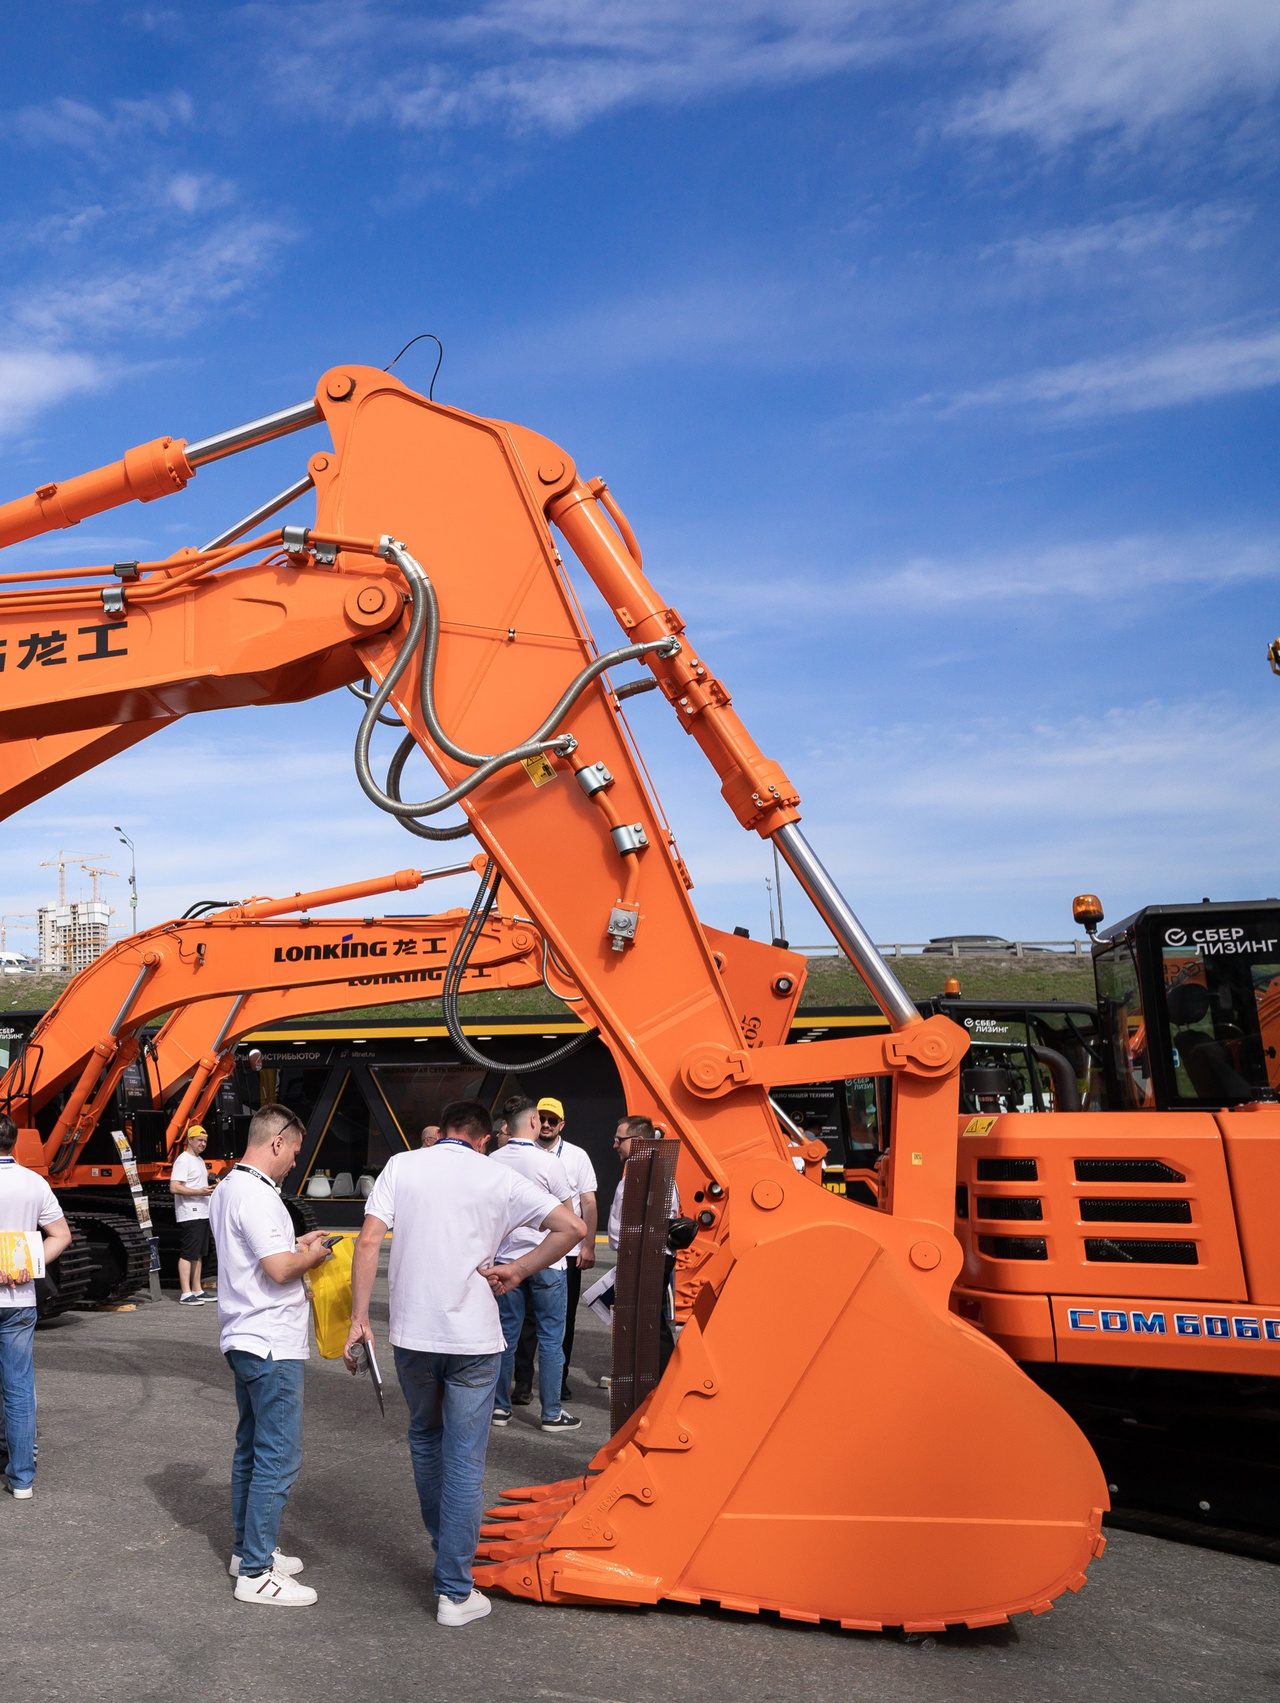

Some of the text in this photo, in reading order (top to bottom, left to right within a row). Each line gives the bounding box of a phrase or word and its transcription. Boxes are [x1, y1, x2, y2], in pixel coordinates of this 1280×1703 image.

[16, 621, 128, 670] 龙工
[1192, 928, 1244, 942] СБЕР
[393, 937, 447, 956] 龙工
[1195, 939, 1278, 955] ЛИЗИНГ
[975, 1019, 997, 1027] СБЕР
[261, 1052, 320, 1061] ИСТРИБЬЮТОР
